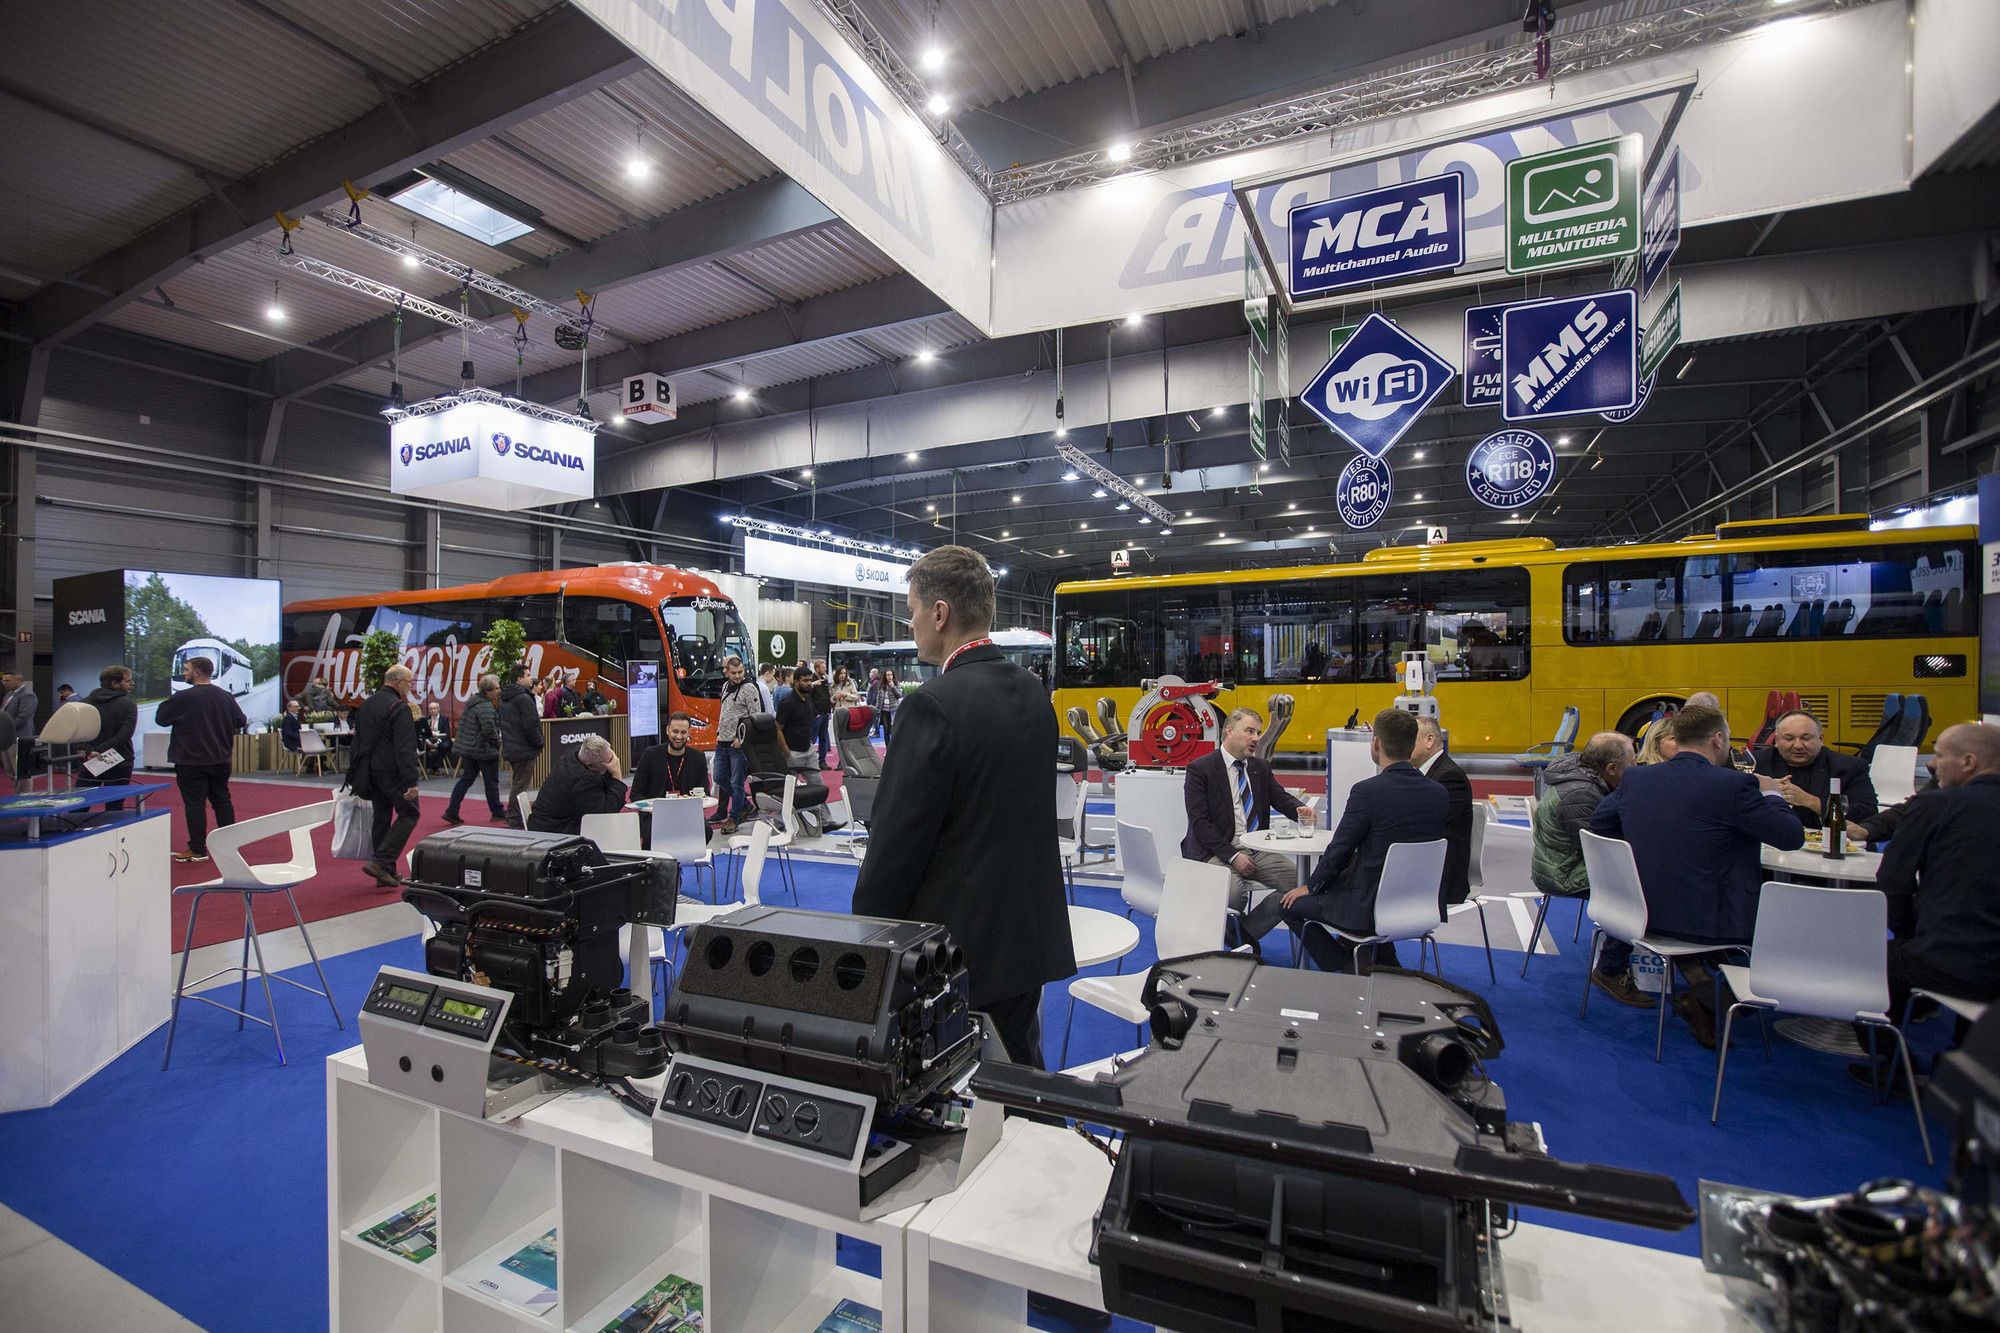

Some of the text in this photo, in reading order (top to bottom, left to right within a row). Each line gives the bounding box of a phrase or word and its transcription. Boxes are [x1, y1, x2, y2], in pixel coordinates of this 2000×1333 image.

[1302, 192, 1448, 261] MCA
[1517, 216, 1628, 247] MULTIMEDIA
[1526, 232, 1620, 259] MONITORS
[1302, 243, 1449, 278] Multichannel Audio
[1511, 300, 1608, 405] MMS
[1532, 353, 1593, 412] Multimedia
[1590, 317, 1627, 356] Server
[629, 379, 645, 403] B
[656, 379, 671, 405] B
[415, 436, 472, 461] SCANIA
[514, 441, 585, 471] SCANIA
[1480, 434, 1534, 455] TESTED
[1498, 450, 1519, 461] ECE
[1345, 457, 1379, 478] TESTED
[1356, 472, 1370, 484] ECE
[1488, 459, 1533, 483] R118
[1350, 481, 1377, 505] R80
[1477, 479, 1542, 505] CERTIFIED
[1342, 499, 1384, 525] CERTIFIED
[1432, 528, 1444, 539] A
[1114, 552, 1123, 562] A
[865, 565, 890, 582] ŠKODA
[68, 608, 107, 626] SCANIA
[1631, 954, 1665, 966] ECO
[1639, 966, 1664, 975] BUS
